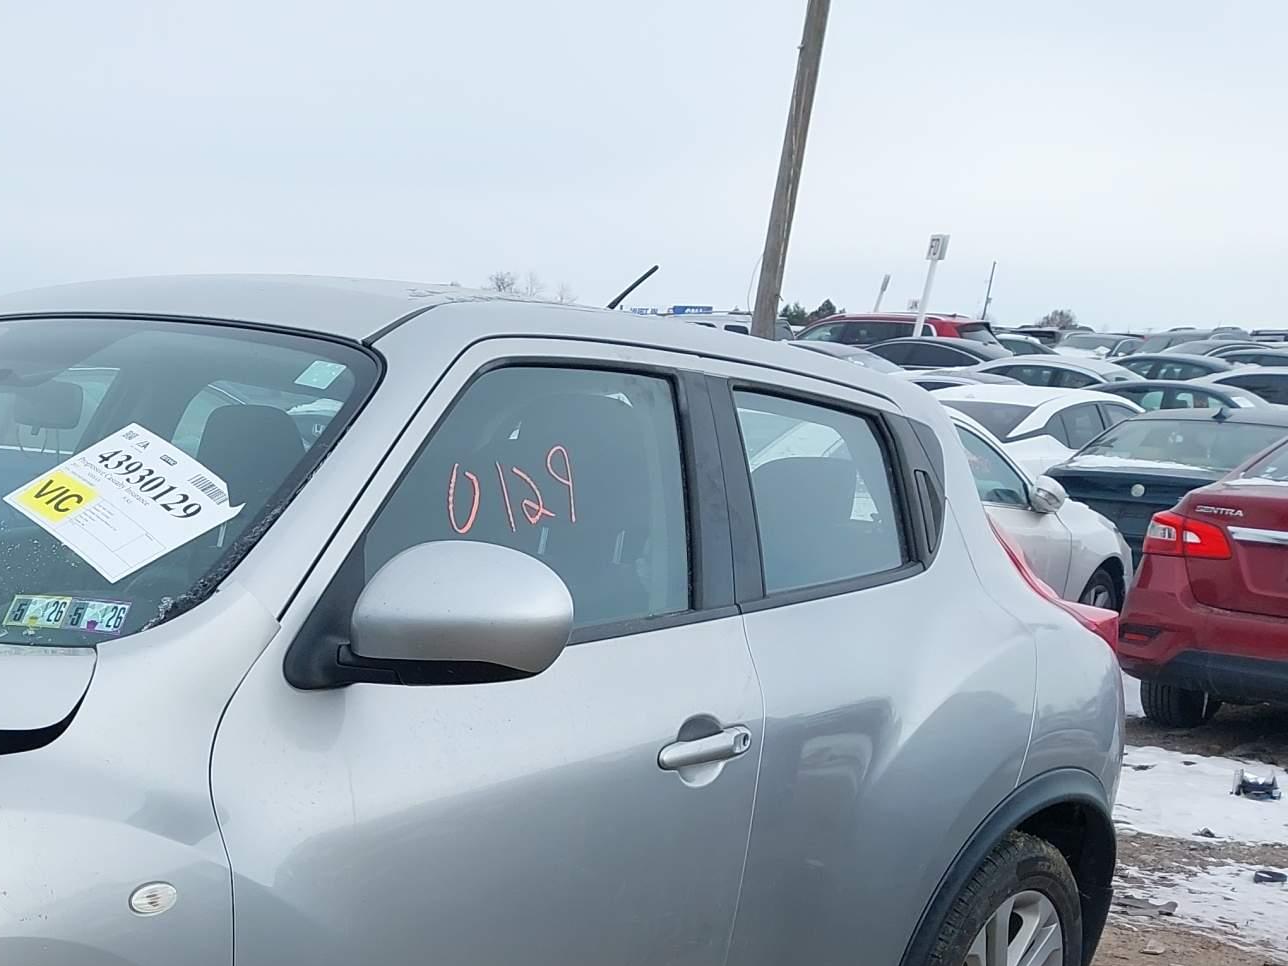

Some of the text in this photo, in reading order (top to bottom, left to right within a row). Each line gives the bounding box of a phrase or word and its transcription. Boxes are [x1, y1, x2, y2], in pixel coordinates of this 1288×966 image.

[33, 479, 83, 514] VIC
[98, 450, 202, 519] 43930129
[447, 445, 576, 535] 0129
[1195, 505, 1244, 517] SENTRA
[47, 600, 67, 623] 26
[106, 605, 126, 629] 26
